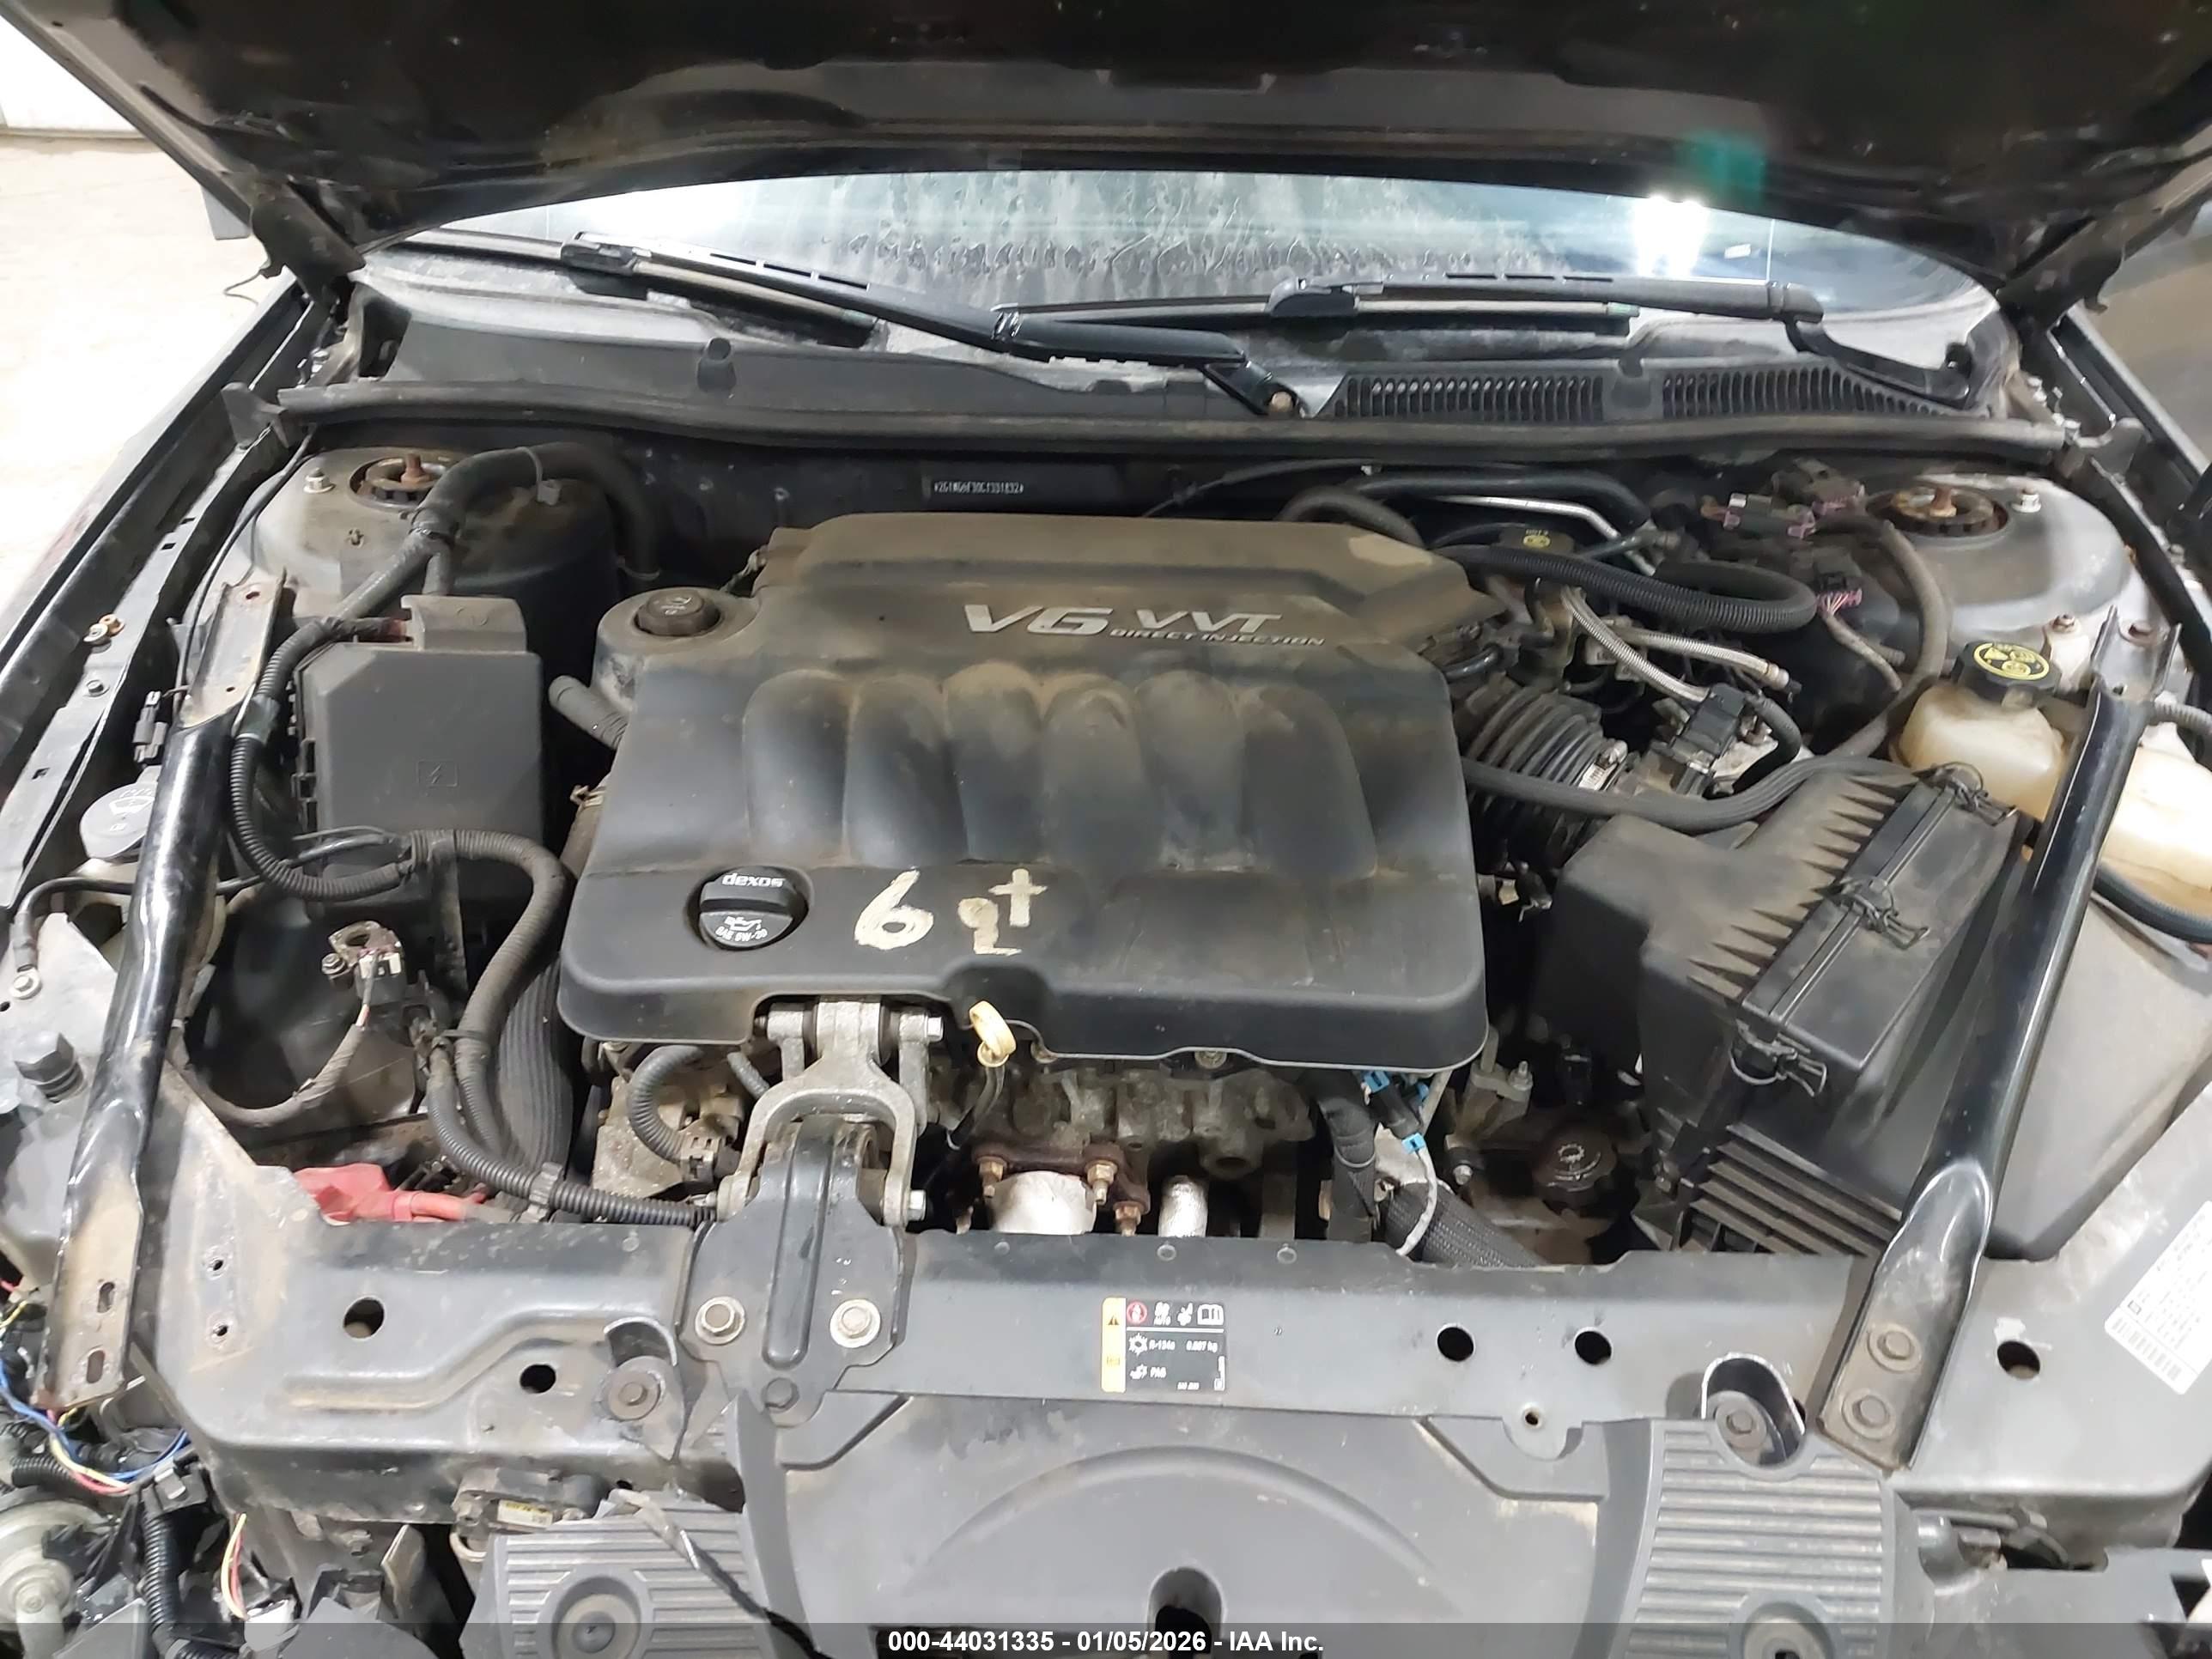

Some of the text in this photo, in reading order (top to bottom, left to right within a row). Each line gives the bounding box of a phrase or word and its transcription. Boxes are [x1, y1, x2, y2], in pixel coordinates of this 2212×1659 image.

[963, 604, 1283, 635] V6 VVT
[1109, 629, 1326, 646] DIRECT INJECTION
[721, 872, 787, 888] dexos
[854, 866, 934, 951] 6
